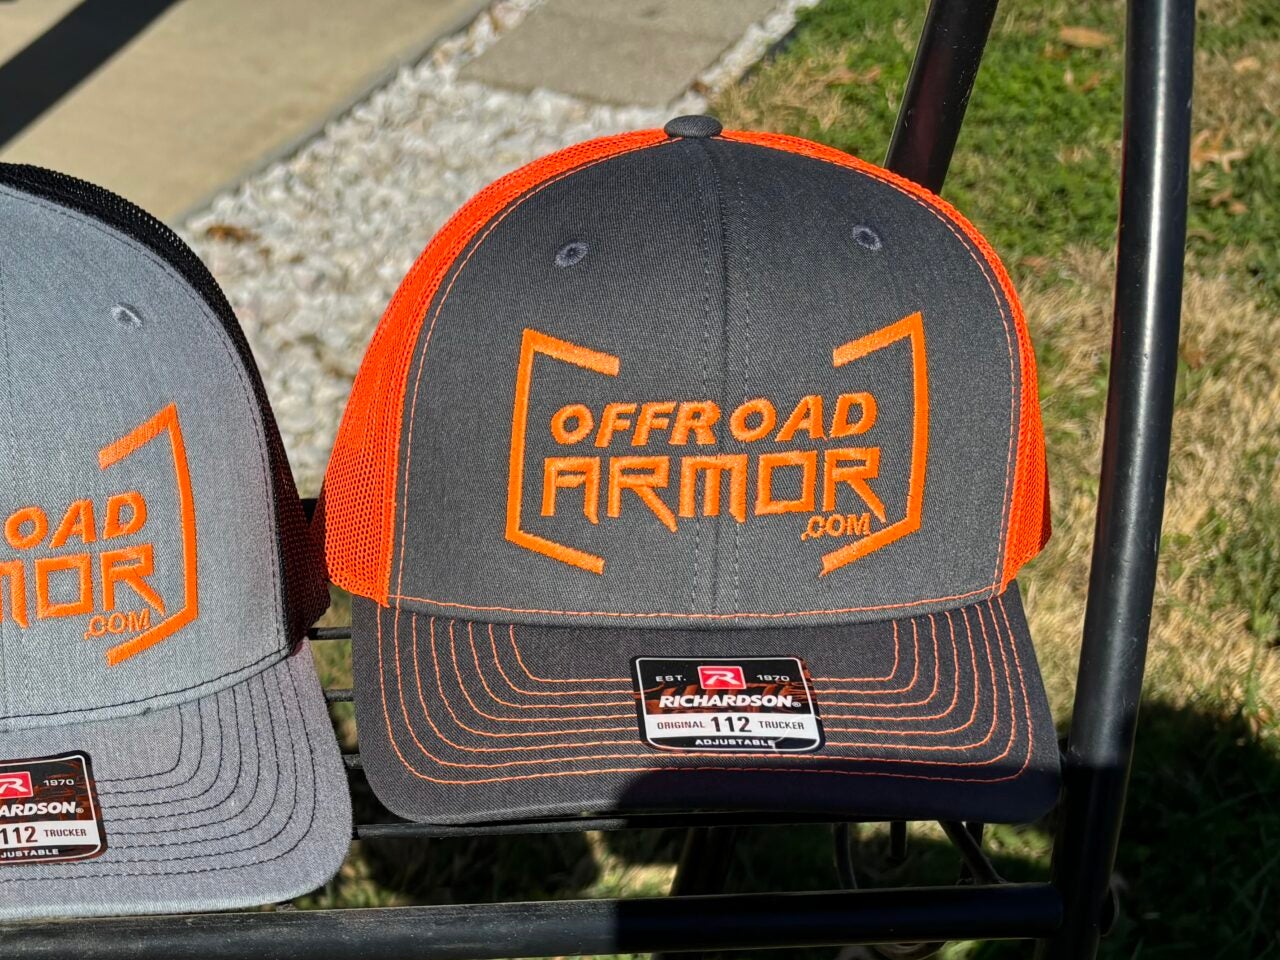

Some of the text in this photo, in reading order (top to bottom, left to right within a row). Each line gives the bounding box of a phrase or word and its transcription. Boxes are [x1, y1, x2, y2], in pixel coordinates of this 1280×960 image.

[551, 391, 877, 448] OFFROAD
[541, 447, 887, 532] ARMOR
[657, 716, 804, 732] ORIGINAL 112 TRUCKER
[0, 826, 38, 844] 112
[44, 829, 87, 837] TRUCKER
